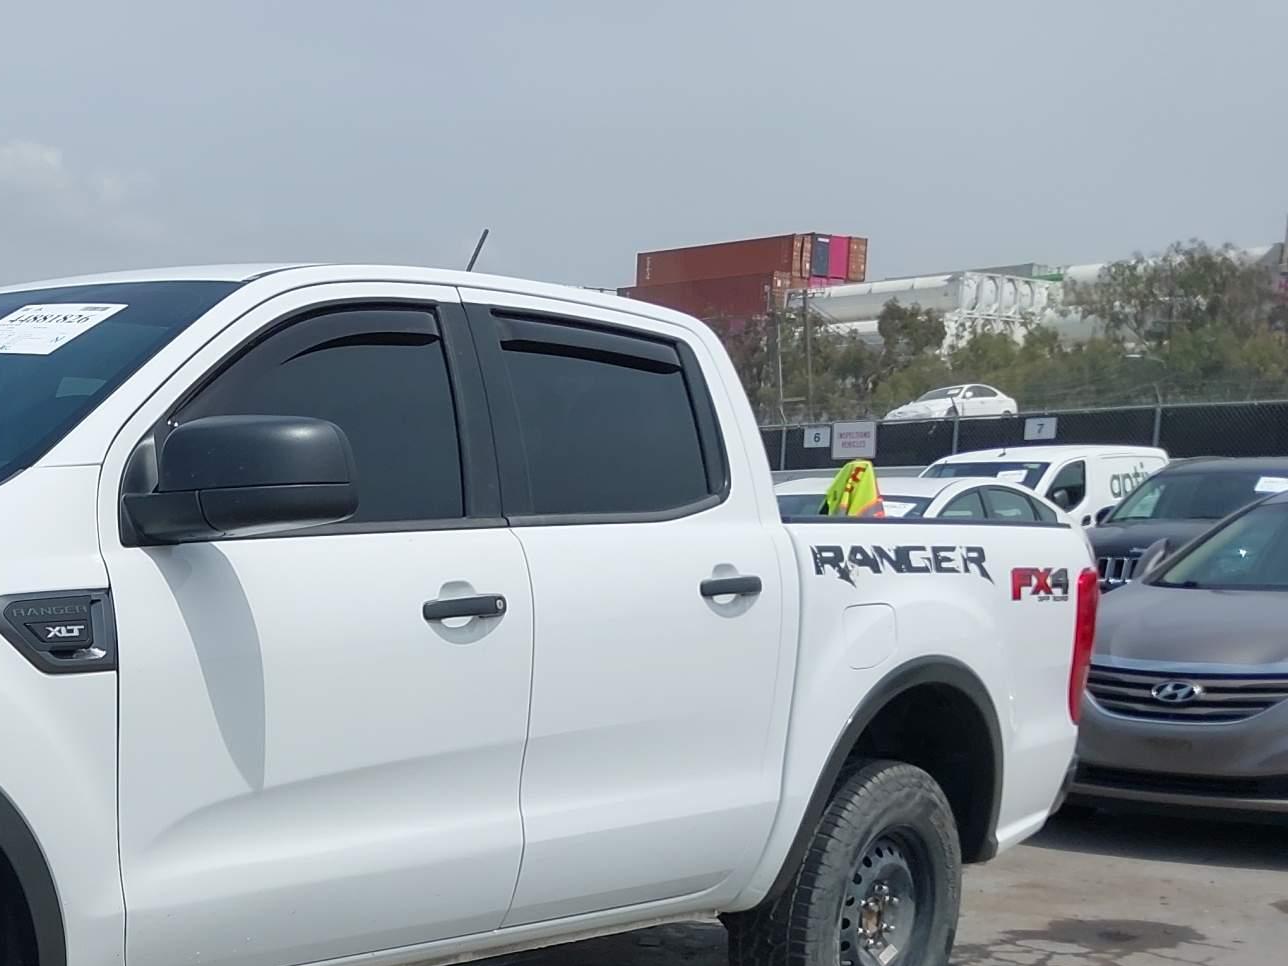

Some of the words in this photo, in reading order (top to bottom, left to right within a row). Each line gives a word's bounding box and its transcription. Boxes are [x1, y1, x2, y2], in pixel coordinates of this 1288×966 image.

[1037, 423, 1044, 433] 7
[814, 433, 821, 442] 6
[810, 545, 995, 588] RANGER
[1011, 567, 1069, 600] FX4
[12, 605, 88, 617] RANGER
[45, 625, 85, 638] XLT
